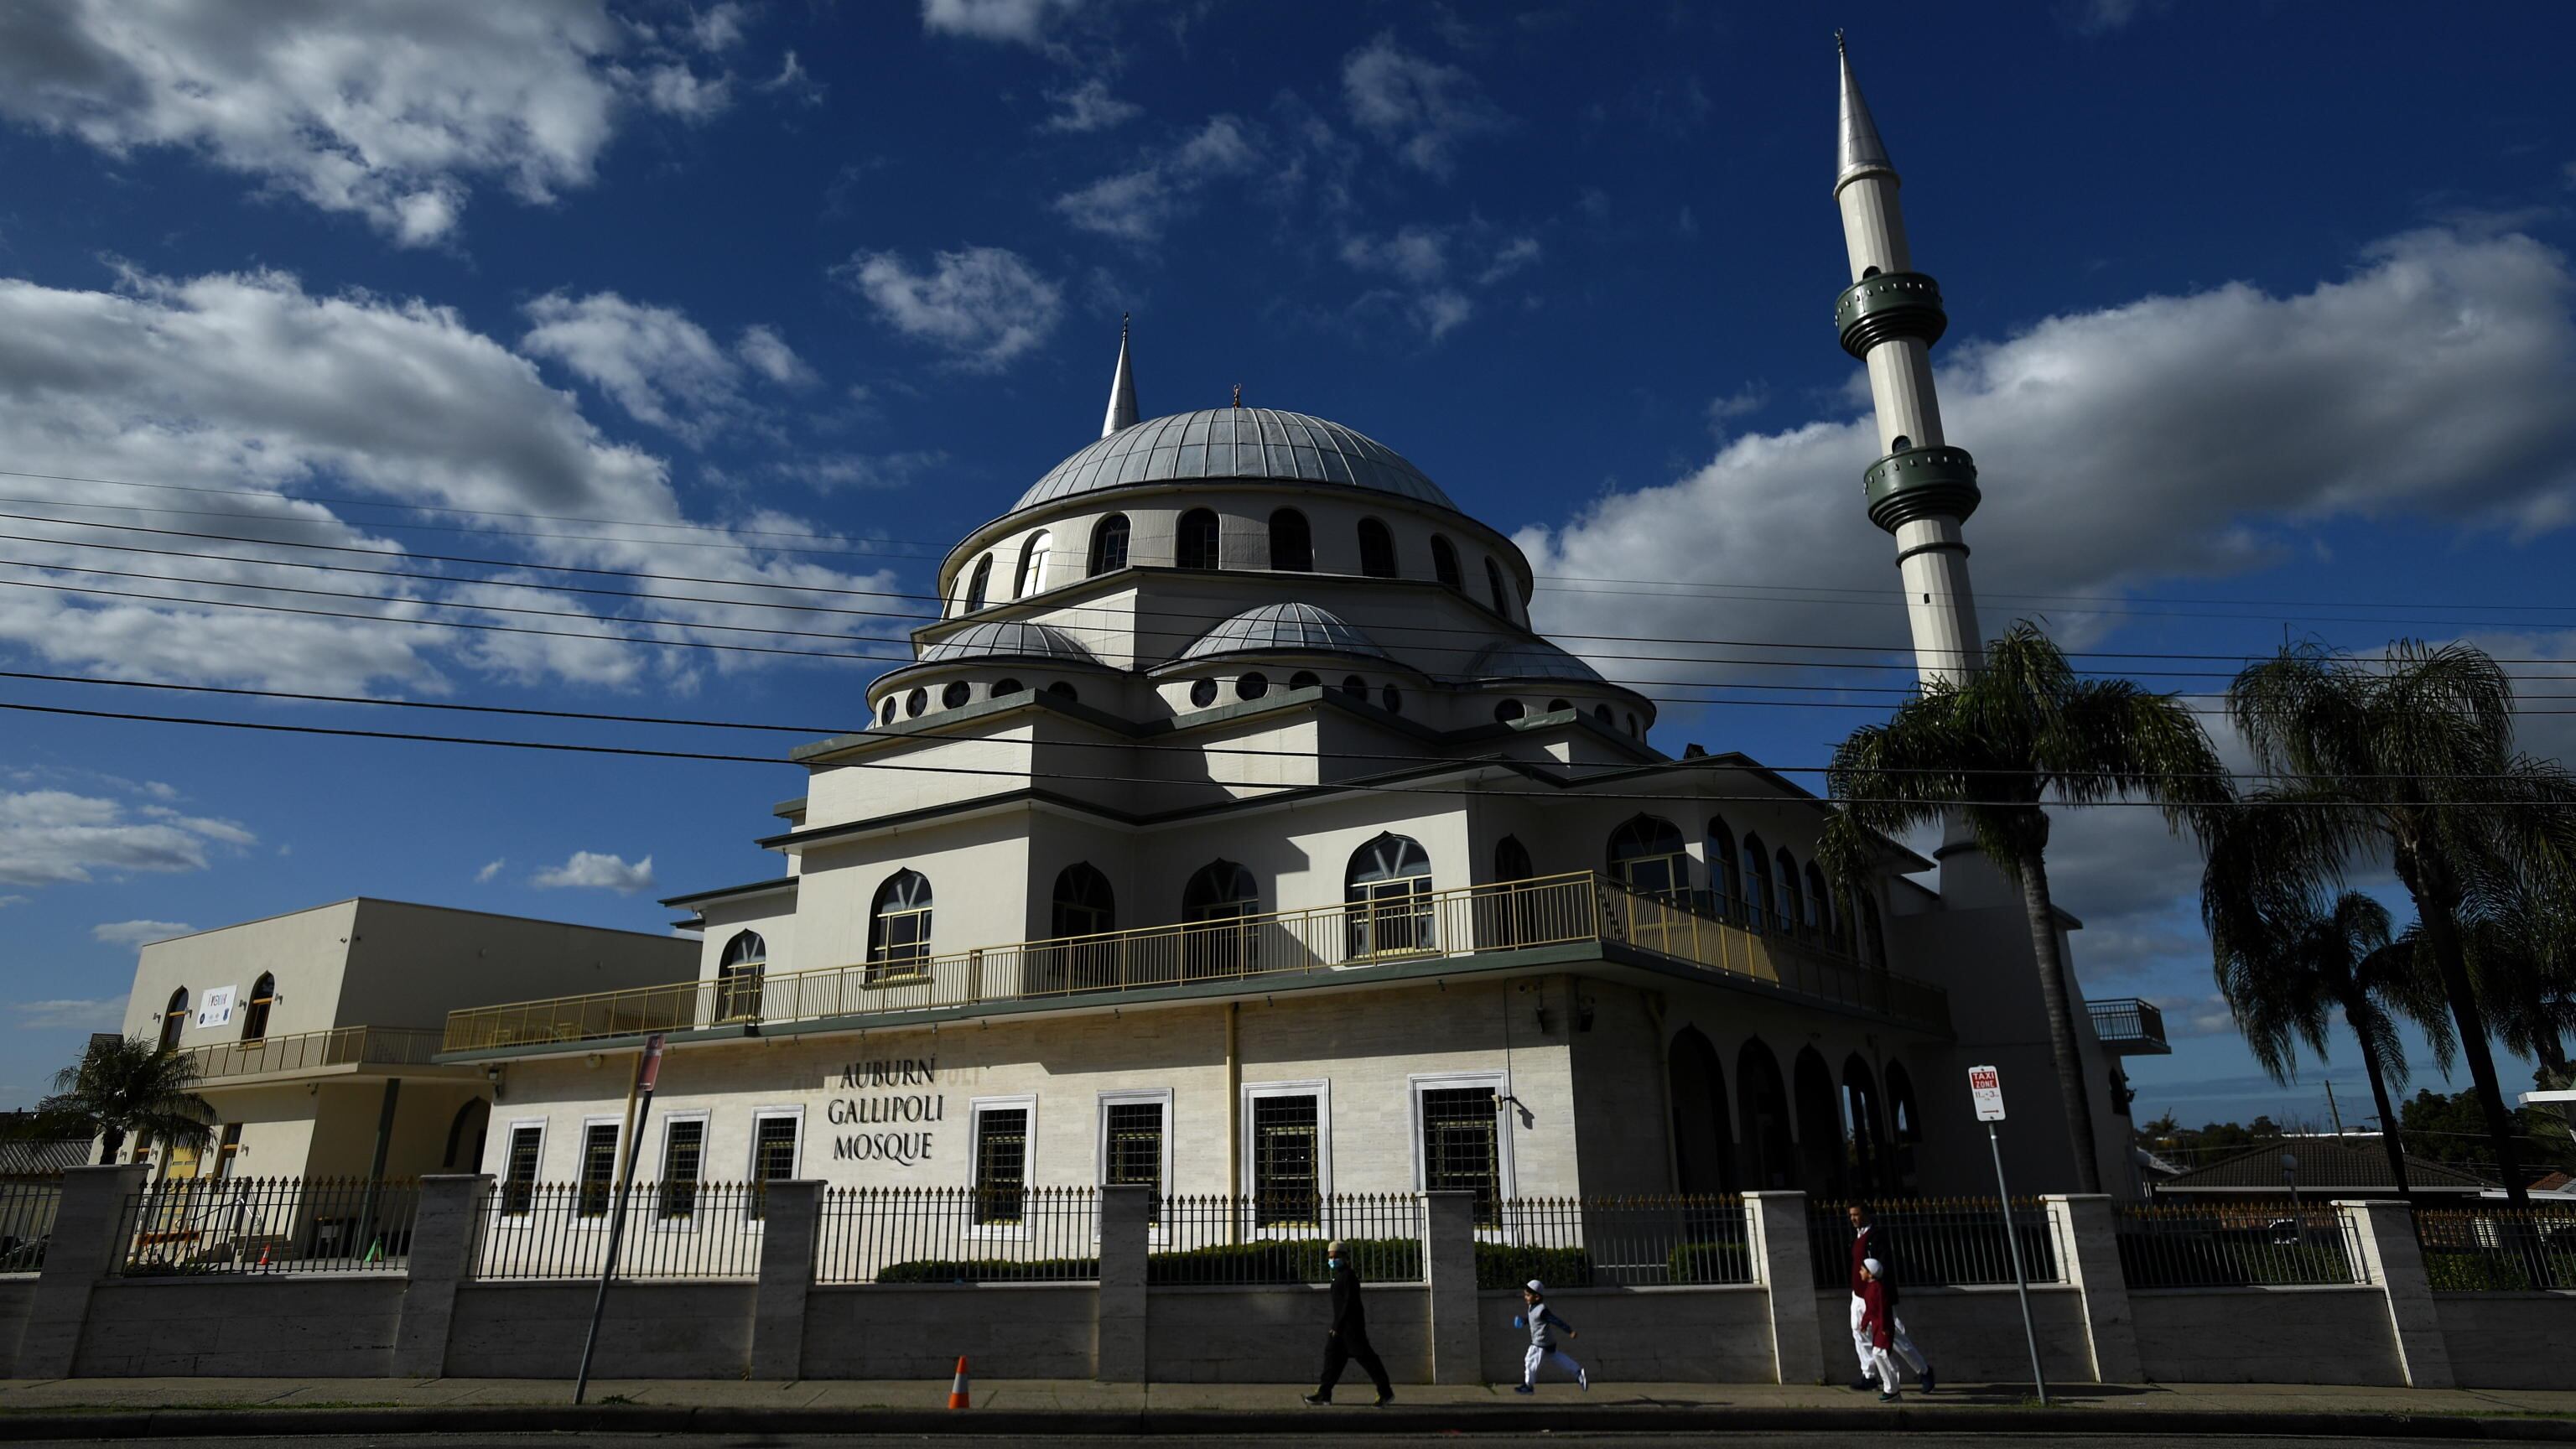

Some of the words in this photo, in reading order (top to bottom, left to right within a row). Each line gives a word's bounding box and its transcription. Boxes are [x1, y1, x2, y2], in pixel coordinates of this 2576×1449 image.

[840, 1057, 935, 1089] AUBURN
[1975, 1080, 1995, 1088] ZONE
[828, 1094, 943, 1124] GALLIPOLI
[834, 1132, 934, 1166] MOSQUE
